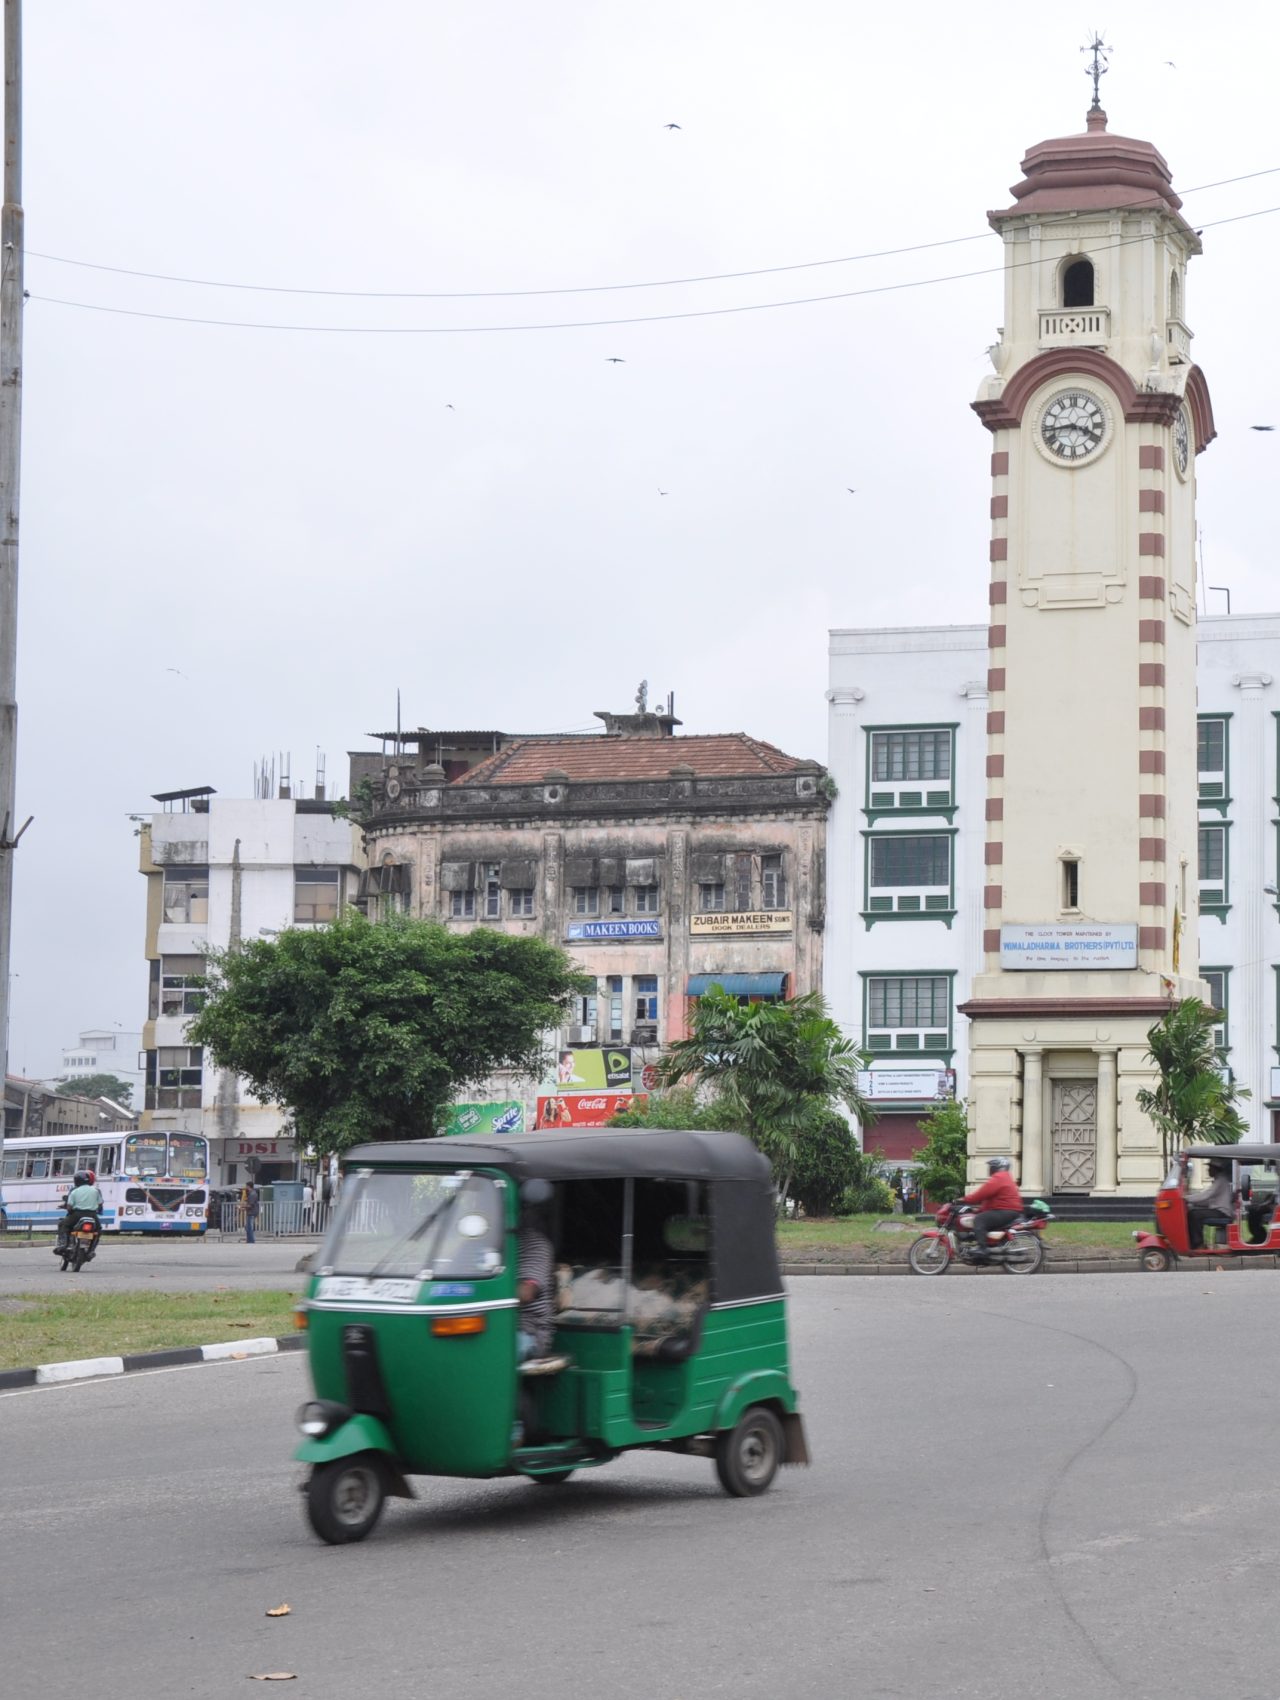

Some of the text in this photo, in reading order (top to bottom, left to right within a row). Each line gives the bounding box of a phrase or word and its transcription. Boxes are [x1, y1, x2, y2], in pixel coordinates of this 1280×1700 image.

[693, 916, 730, 930] ZUBAIR
[731, 914, 773, 929] MAKEEN
[585, 922, 658, 936] MAKEEN BOOKS
[1003, 941, 1060, 951] WIMALADHARMA
[577, 1098, 608, 1111] Coca-Cola
[492, 1107, 519, 1131] Sprite
[238, 1142, 279, 1155] DSI
